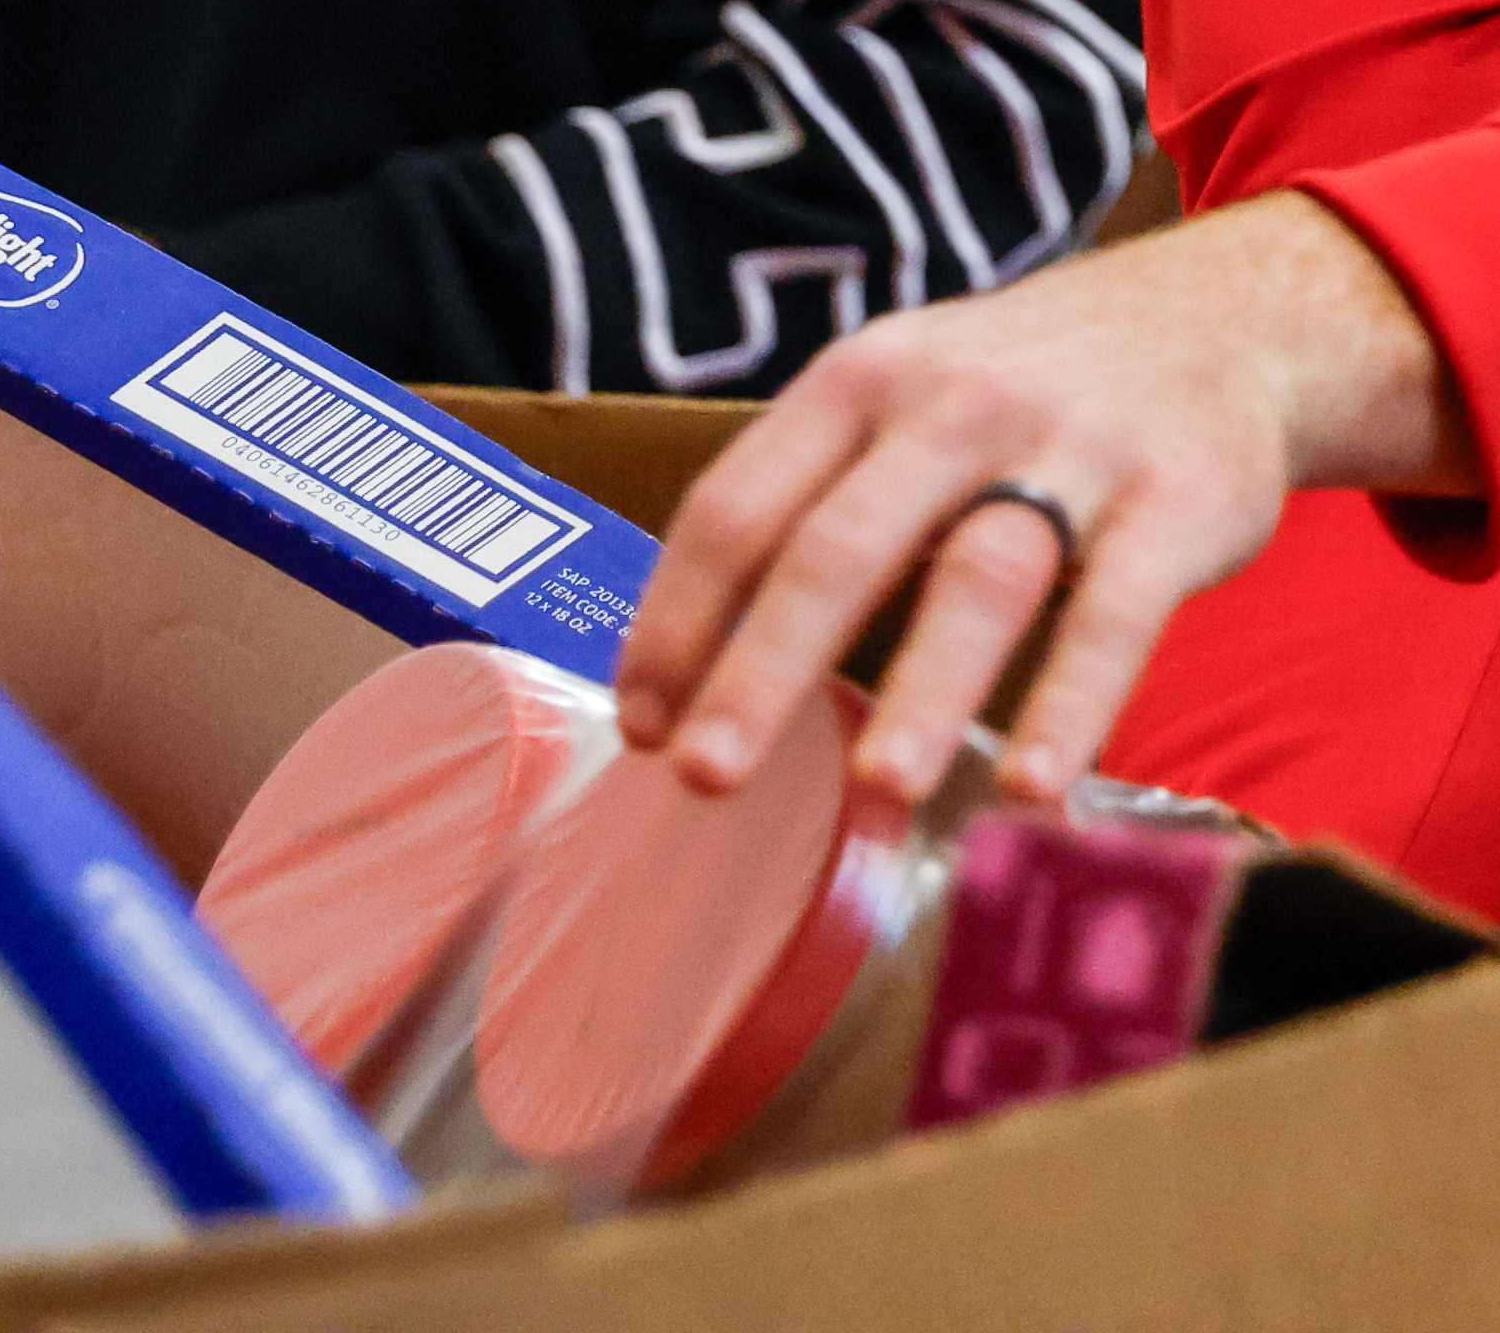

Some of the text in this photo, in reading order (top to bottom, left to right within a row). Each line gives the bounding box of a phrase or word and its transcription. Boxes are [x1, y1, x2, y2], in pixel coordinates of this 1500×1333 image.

[221, 435, 401, 542] 04061462861130
[524, 591, 544, 607] 12
[551, 606, 572, 622] 18
[540, 579, 578, 605] ITEM
[574, 599, 619, 630] CODE:
